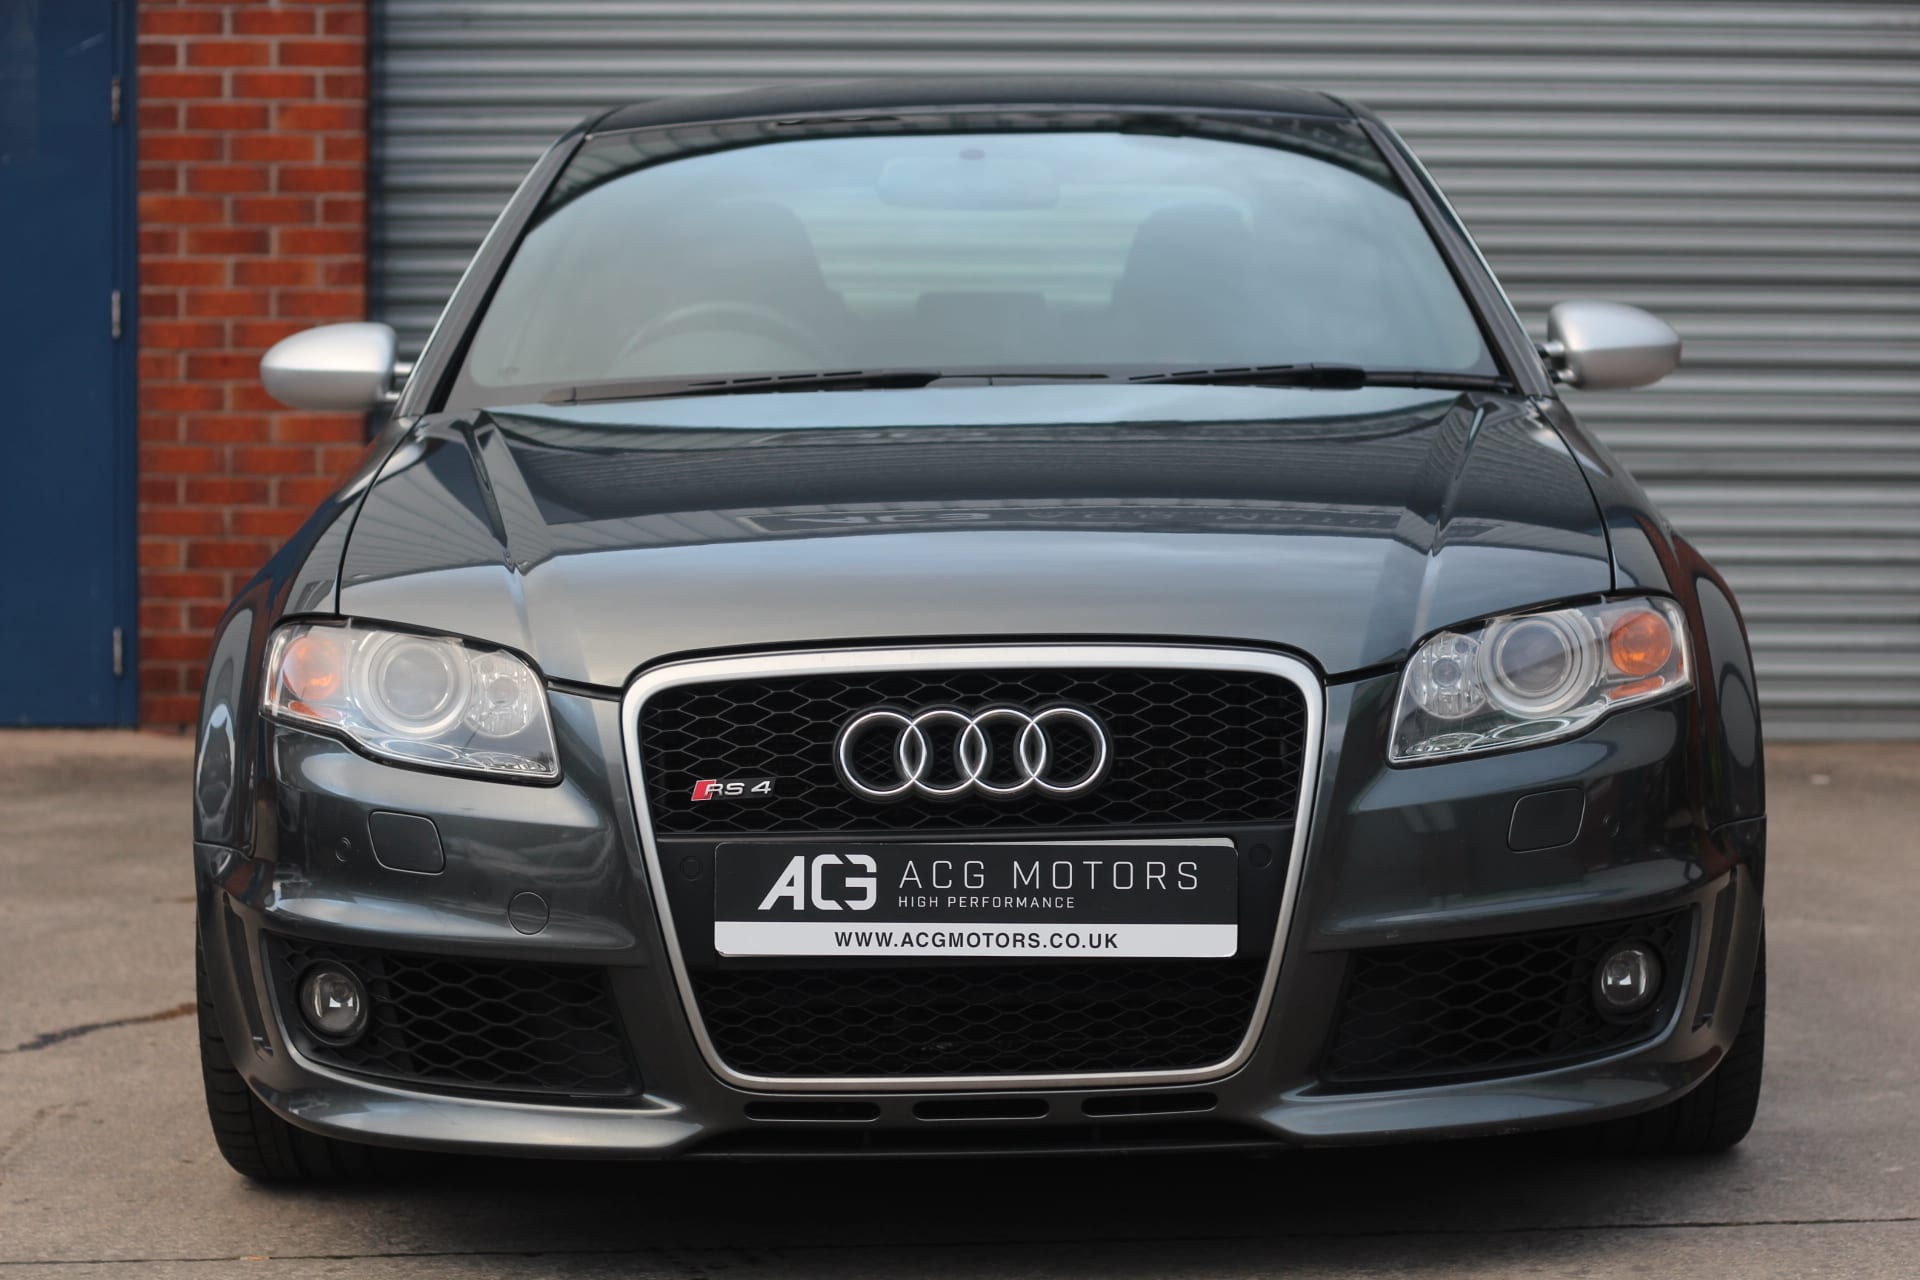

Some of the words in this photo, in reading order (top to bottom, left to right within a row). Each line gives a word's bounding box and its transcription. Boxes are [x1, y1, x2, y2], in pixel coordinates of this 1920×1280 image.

[704, 783, 745, 796] RS
[751, 781, 772, 794] 4
[757, 854, 877, 911] ACG
[899, 860, 985, 889] ACG
[1013, 860, 1198, 890] MOTORS
[898, 896, 938, 908] HIGH
[947, 896, 1075, 909] PERFORMANCE
[834, 931, 1118, 949] WWW.ACGMOTORS.CO.UK
